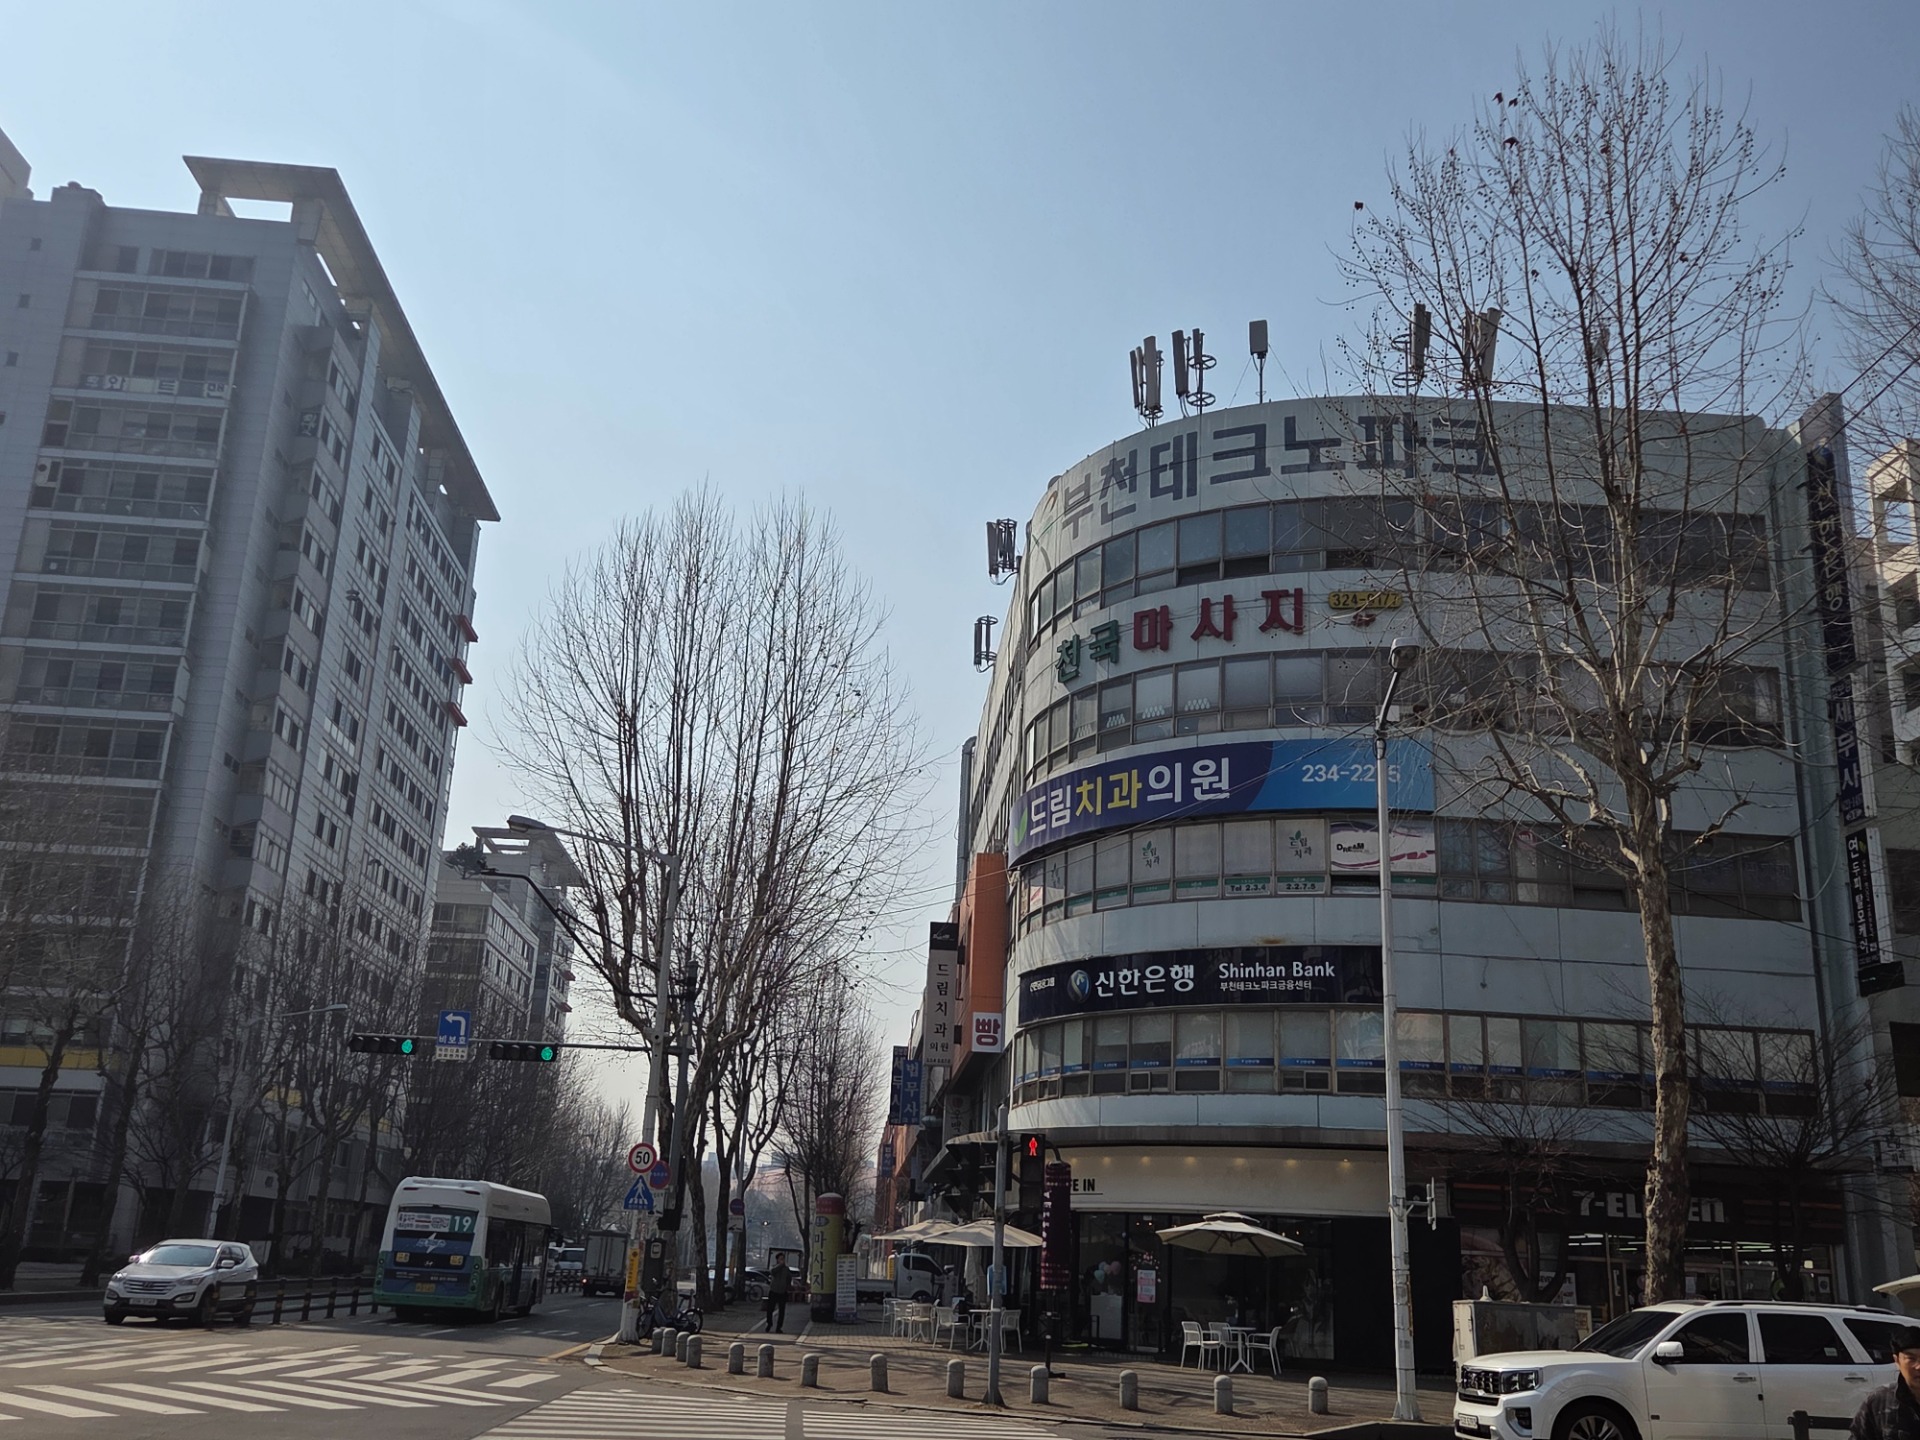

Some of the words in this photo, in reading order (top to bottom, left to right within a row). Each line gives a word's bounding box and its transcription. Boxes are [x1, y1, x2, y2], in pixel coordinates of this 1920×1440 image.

[1055, 619, 1121, 683] 천국
[1133, 588, 1304, 652] 마사지
[1836, 703, 1862, 790] 세무사
[1336, 842, 1365, 853] DREAM
[1095, 964, 1195, 998] 신한은행
[1218, 962, 1287, 979] Shinhan
[1292, 961, 1335, 978] Bank
[934, 963, 949, 1037] 드림치과
[438, 1035, 466, 1045] 비보호
[975, 1018, 1001, 1046] 빵
[929, 1041, 949, 1052] 의원
[904, 1062, 919, 1117] 법무사
[635, 1151, 650, 1165] 50
[1083, 1178, 1095, 1192] IN
[454, 1215, 472, 1231] 19
[813, 1230, 826, 1291] 마사지
